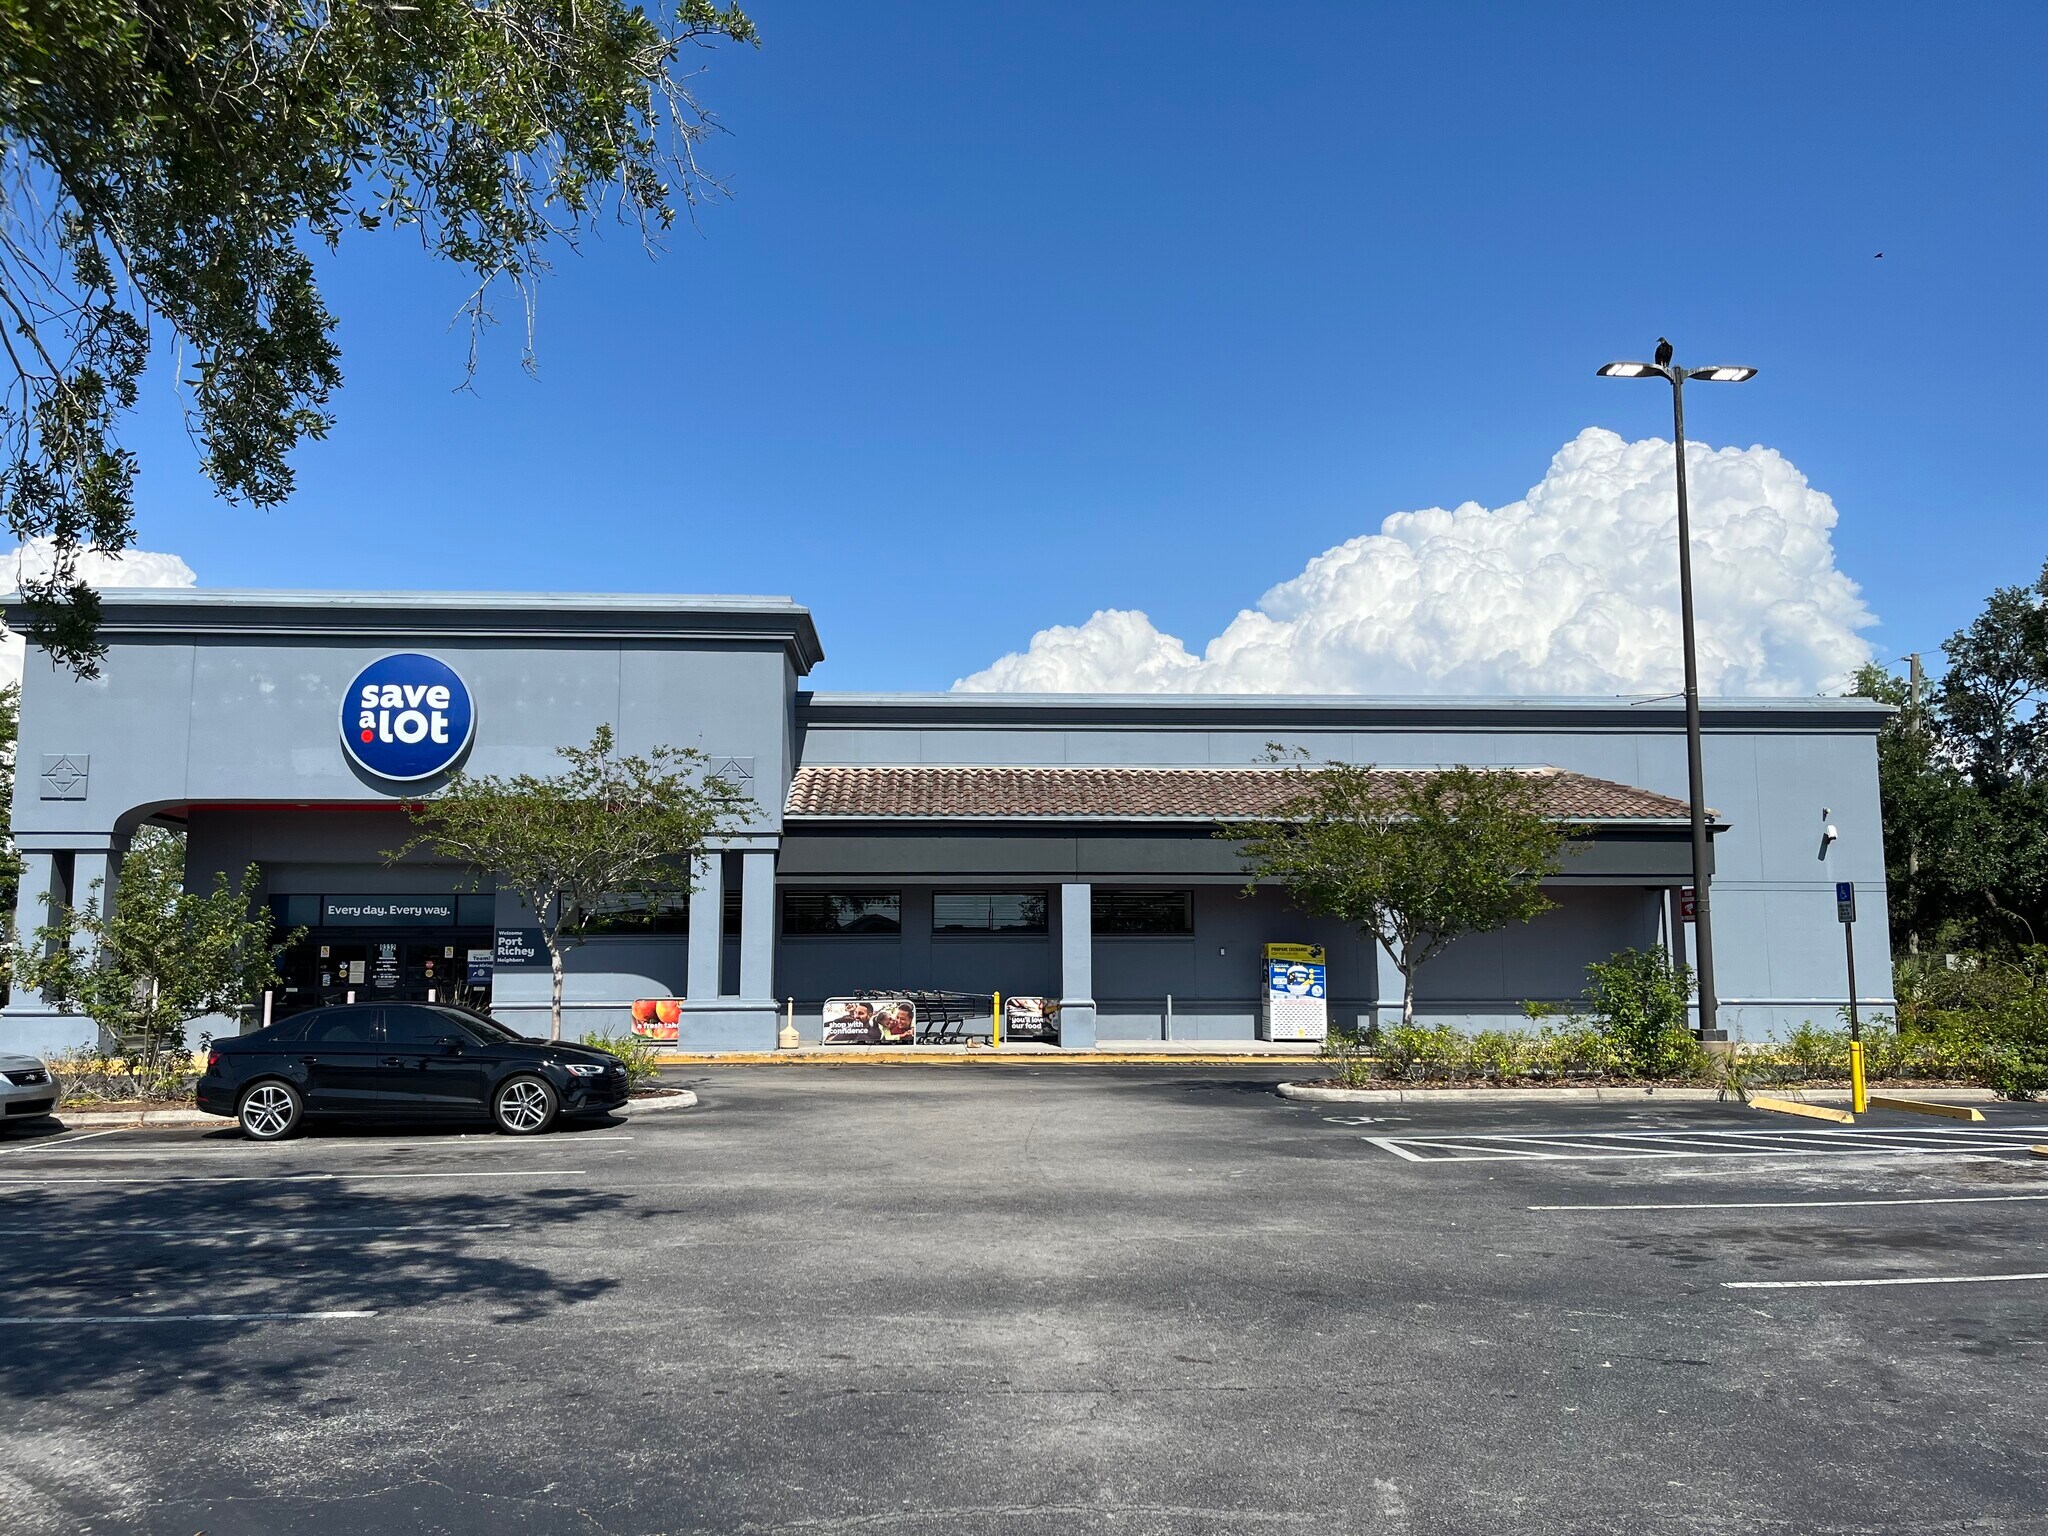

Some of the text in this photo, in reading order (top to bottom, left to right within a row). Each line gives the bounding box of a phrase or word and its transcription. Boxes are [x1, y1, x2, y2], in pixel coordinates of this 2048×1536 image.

[361, 684, 450, 709] save
[359, 710, 376, 729] a
[328, 905, 450, 917] Every day. Every way.
[498, 937, 523, 946] Port
[497, 946, 535, 957] Richey
[847, 1020, 864, 1028] with
